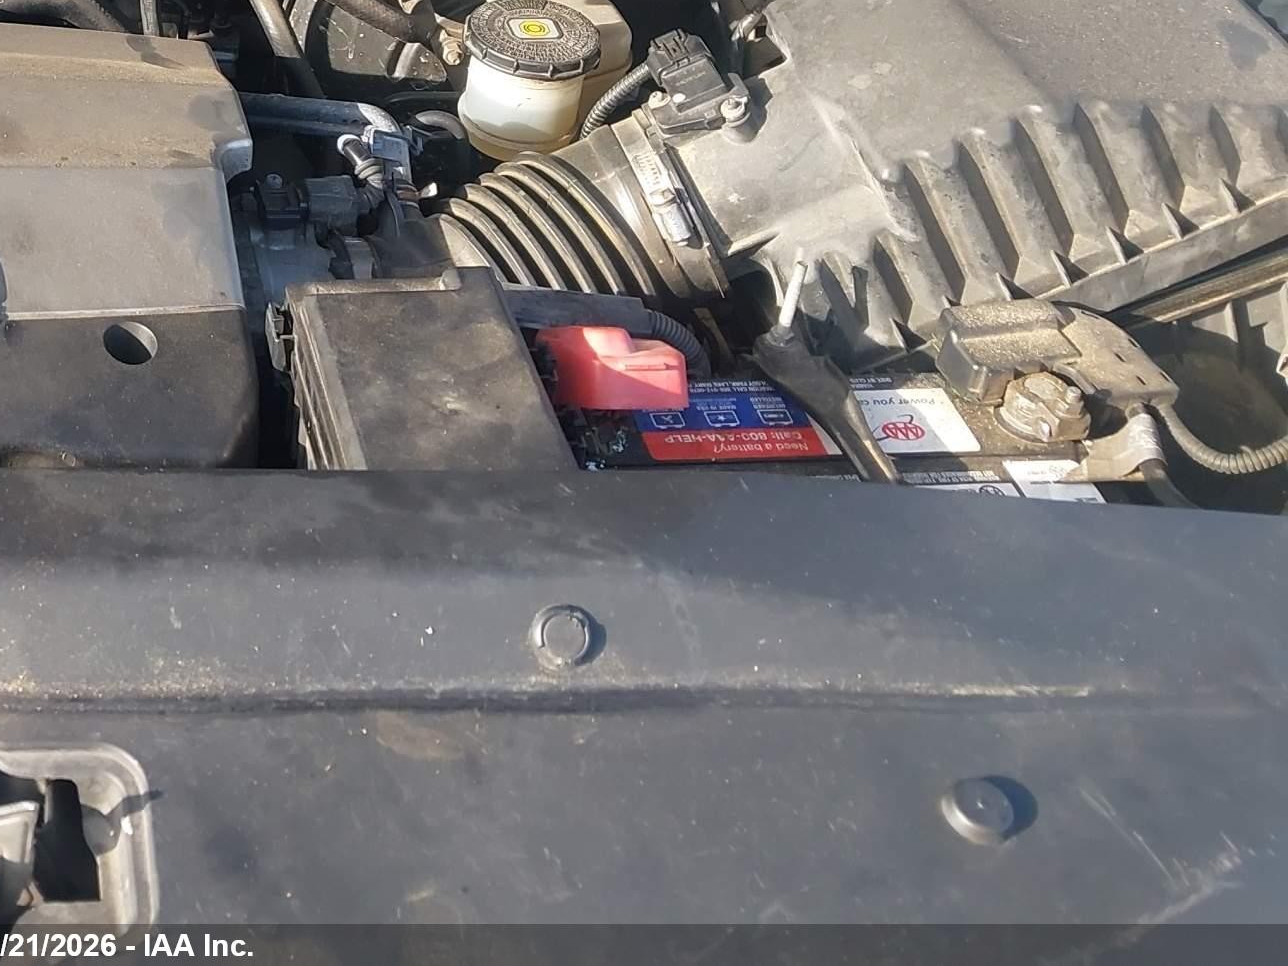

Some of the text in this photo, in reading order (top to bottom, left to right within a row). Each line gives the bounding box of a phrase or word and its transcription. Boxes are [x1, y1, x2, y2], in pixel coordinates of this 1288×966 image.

[873, 397, 895, 405] you
[898, 397, 935, 406] Power
[885, 423, 921, 439] AAA
[665, 431, 803, 443] Call: 800-AAA-HELP
[713, 442, 762, 454] battery?
[777, 442, 809, 451] Need
